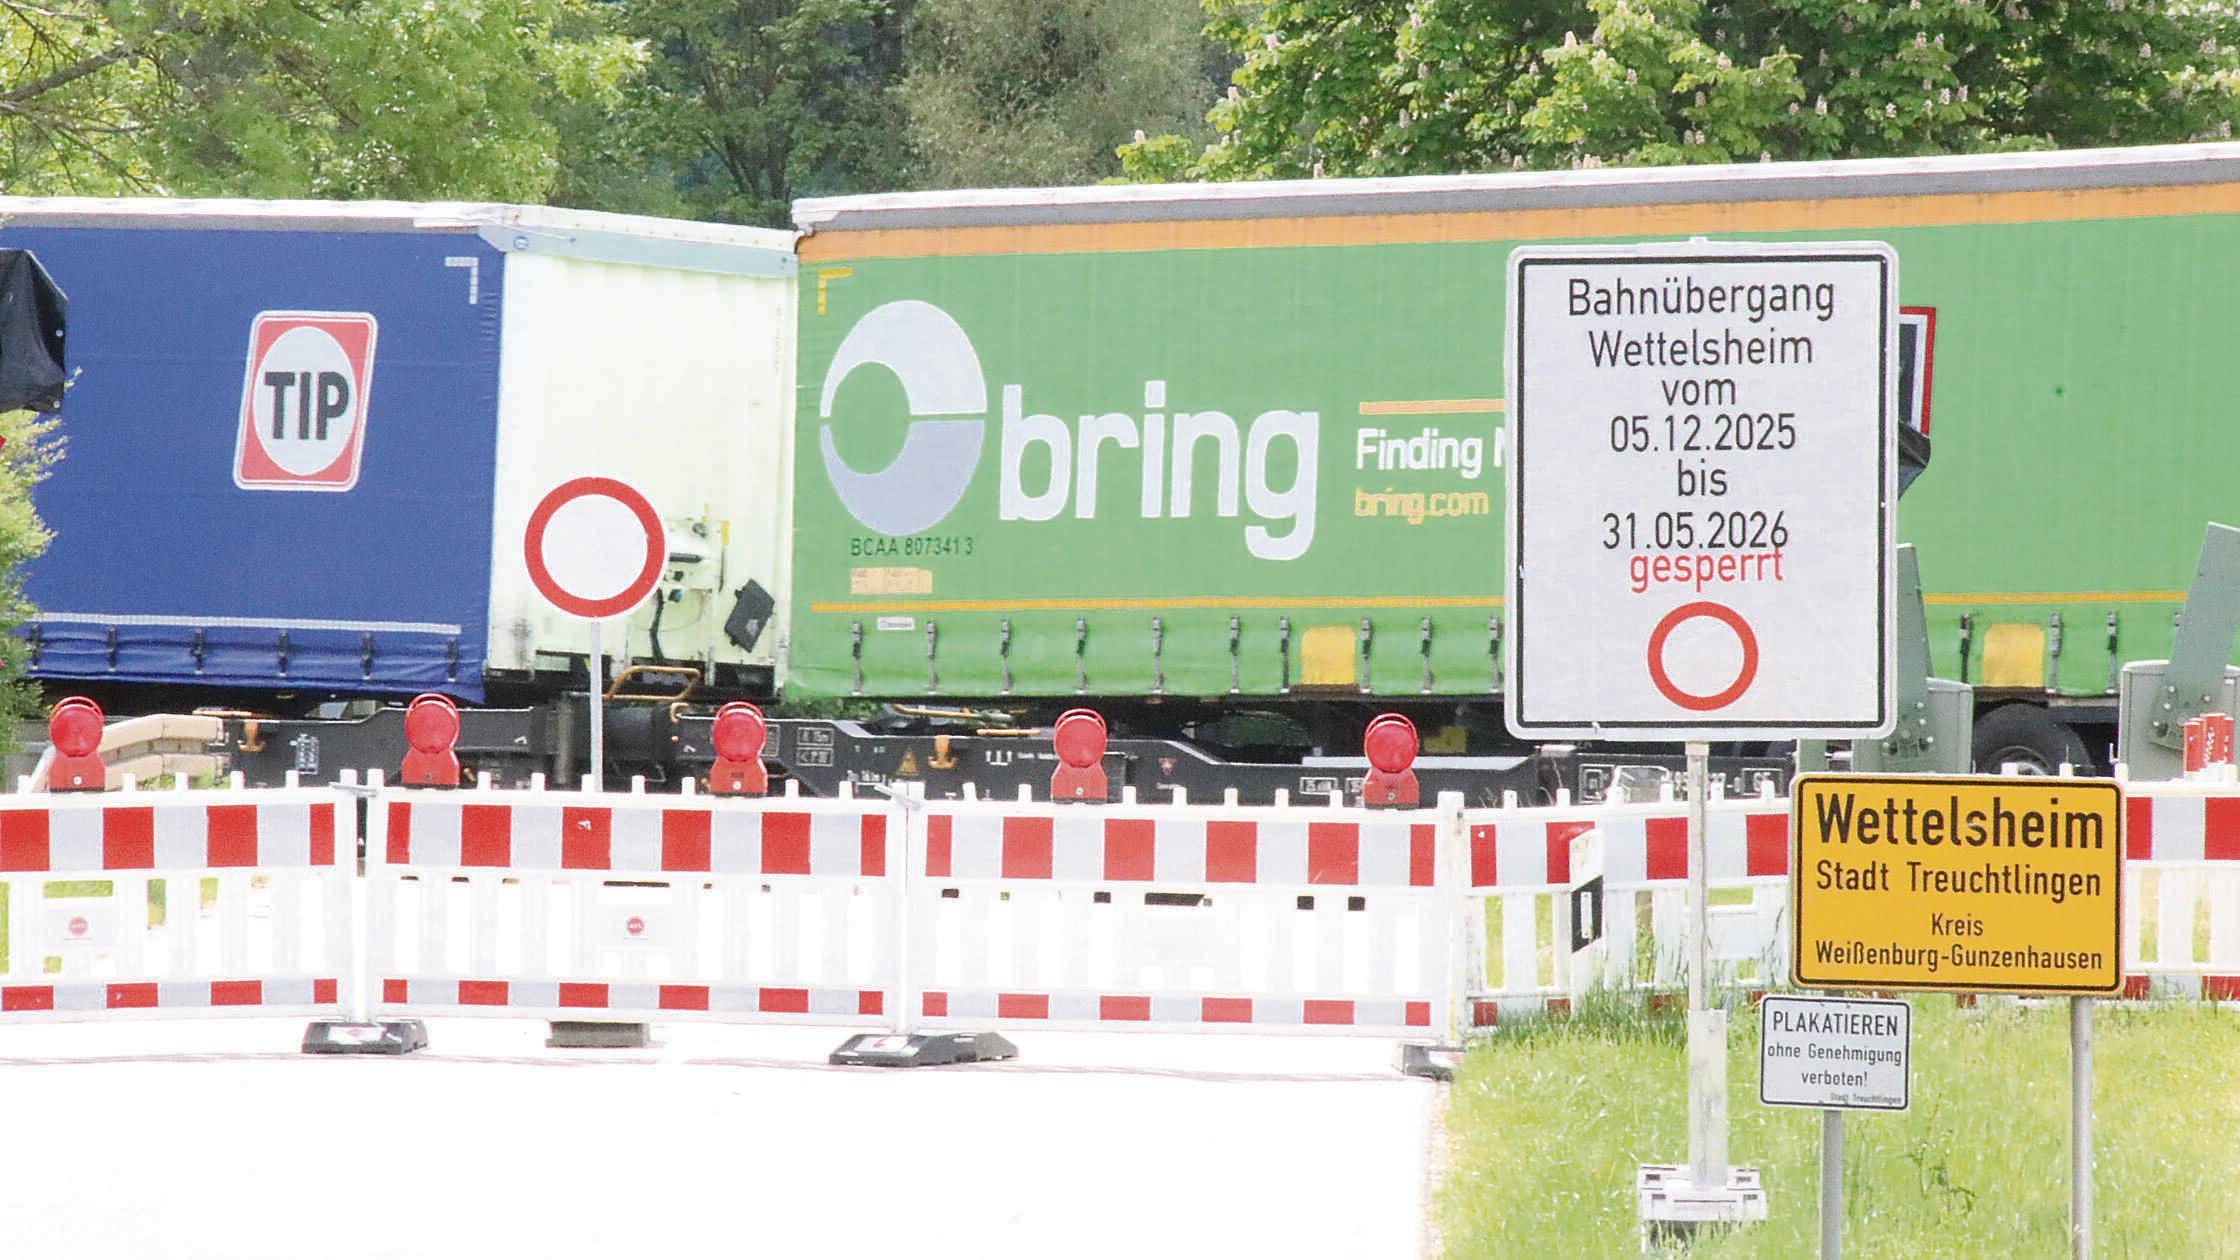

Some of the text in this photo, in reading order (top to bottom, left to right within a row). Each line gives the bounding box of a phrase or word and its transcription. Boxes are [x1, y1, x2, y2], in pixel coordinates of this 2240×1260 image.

[1568, 276, 1835, 323] Bahnübergang
[1588, 327, 1813, 367] Wettelsheim
[264, 371, 349, 440] TIP
[1661, 378, 1737, 406] vom
[1610, 412, 1797, 452] 05.12.2025
[999, 379, 1320, 561] bring
[1356, 427, 1483, 480] Finding
[1677, 458, 1729, 497] bis
[1355, 487, 1489, 526] bring.com
[850, 538, 899, 556] BCAA
[1602, 510, 1789, 549] 31.05.2026
[1630, 546, 1784, 594] gesperrt
[1815, 792, 2103, 849] Wettelsheim
[1816, 859, 2101, 904] Stadt Treuchtlingen
[1931, 912, 1984, 937] Kreis
[1815, 939, 2103, 973] Weißenburg-Gunzenhausen
[1772, 1010, 1898, 1037] PLAKATIEREN
[1767, 1042, 1902, 1067] ohne Genehmigung
[1801, 1070, 1868, 1087] verboten!
